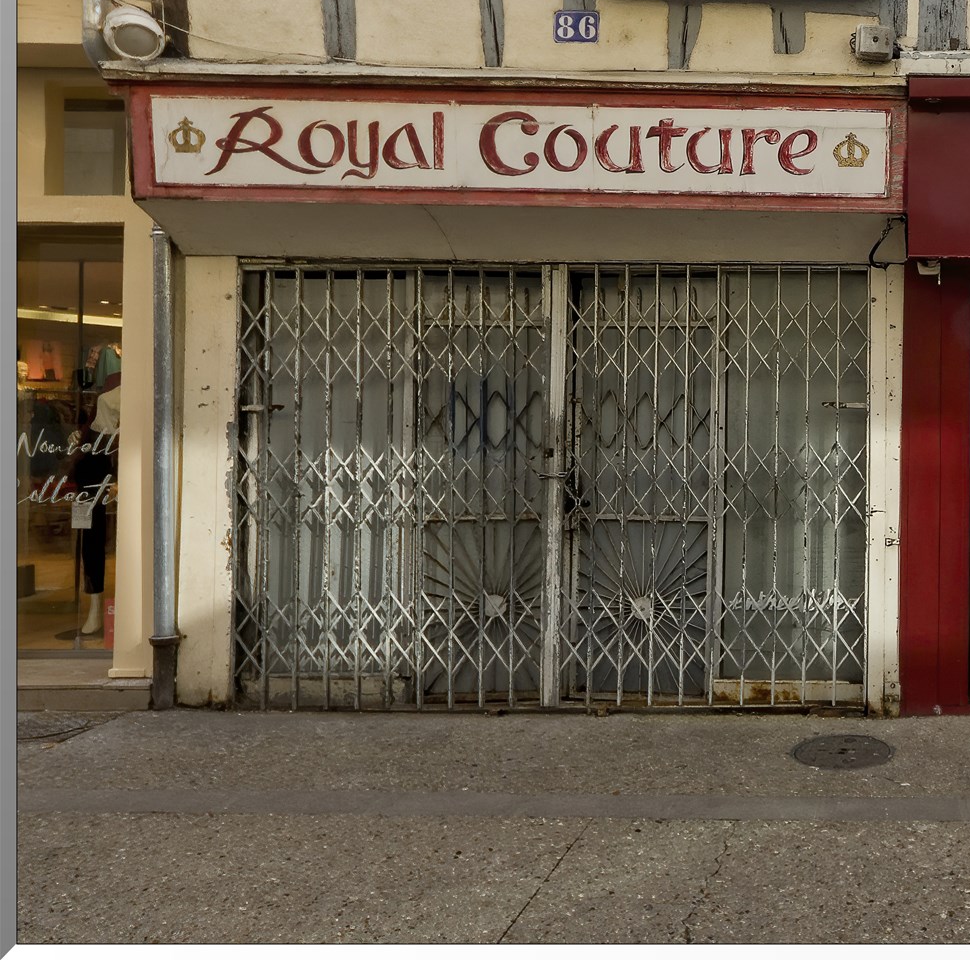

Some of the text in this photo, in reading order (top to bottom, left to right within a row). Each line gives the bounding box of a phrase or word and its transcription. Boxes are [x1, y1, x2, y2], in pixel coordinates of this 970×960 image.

[556, 15, 597, 40] 86
[204, 105, 819, 181] Royal Couture
